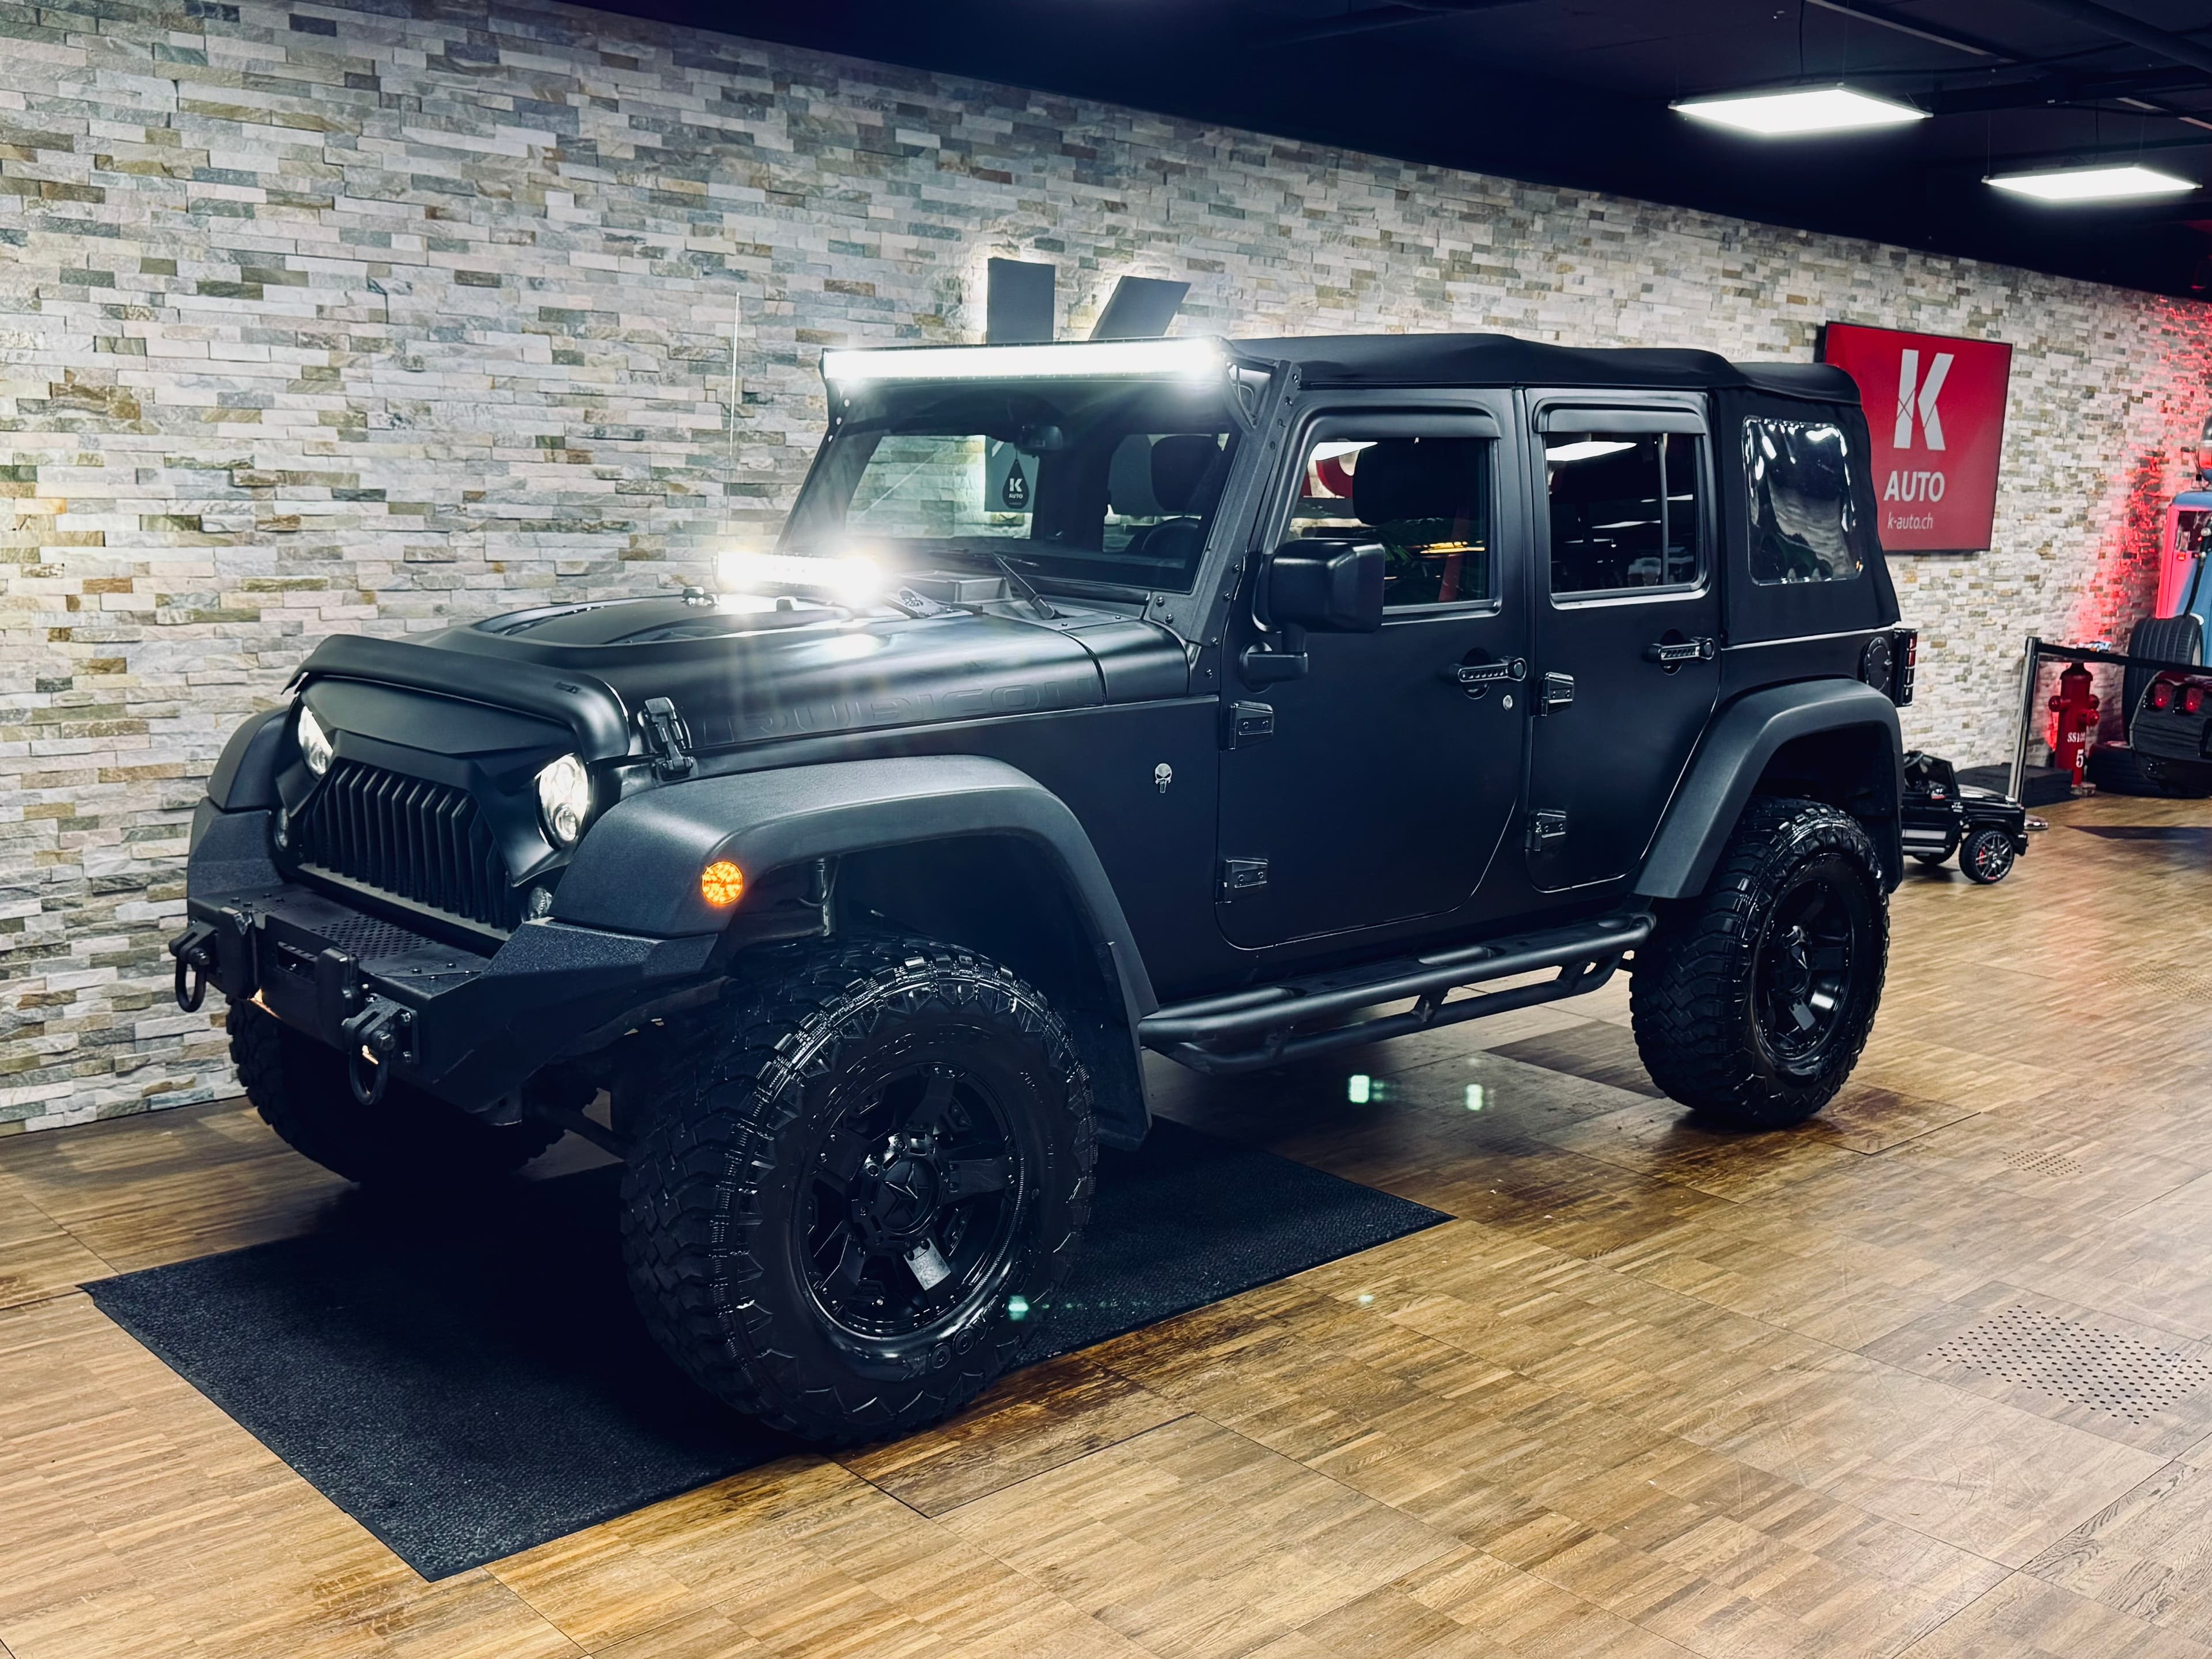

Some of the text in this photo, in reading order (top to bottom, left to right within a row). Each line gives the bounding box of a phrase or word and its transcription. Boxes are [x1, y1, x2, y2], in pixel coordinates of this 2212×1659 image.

[1893, 349, 1955, 451] K
[1010, 478, 1022, 492] K
[1883, 470, 1945, 502] AUTO
[1887, 512, 1933, 531] k-auto.ch
[703, 676, 1092, 744] RUBICON
[2075, 749, 2084, 768] 5
